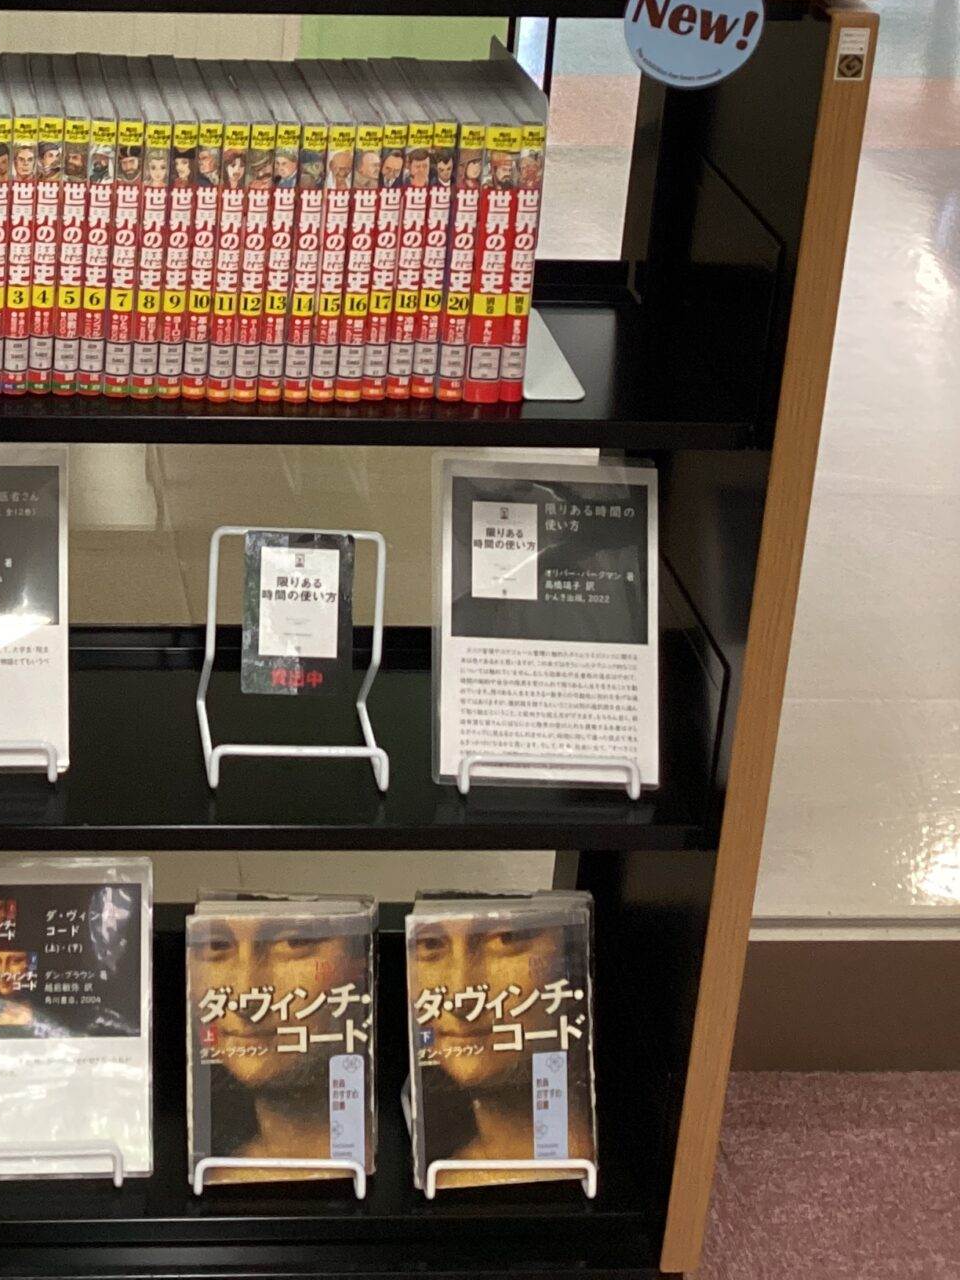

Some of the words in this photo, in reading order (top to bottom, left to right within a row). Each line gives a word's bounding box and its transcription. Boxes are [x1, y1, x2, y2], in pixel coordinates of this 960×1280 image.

[8, 182, 35, 286] 世界の歴史
[33, 182, 59, 285] 世界の歴史
[59, 182, 86, 286] 世界の歴史
[85, 184, 112, 286] 世界の歴史
[111, 185, 139, 288] 世界の歴史
[140, 186, 167, 291] 世界の歴史
[165, 187, 193, 291] 世界の歴史
[191, 186, 218, 290] 世界の歴史
[216, 189, 244, 293] 世界の歴史
[242, 189, 270, 293] 世界の歴史
[267, 188, 295, 291] 世界の歴史
[294, 189, 323, 292] 世界の歴史
[347, 190, 377, 292] 世界の歴史
[372, 187, 401, 290] 世界の歴史
[398, 187, 427, 290] 世界の歴史
[422, 186, 451, 289] 世界の歴史
[450, 189, 479, 292] 世界の歴史
[320, 190, 350, 293] 世界の歴史
[480, 190, 512, 294] 世界の歴史
[509, 190, 539, 294] 世界の歴史
[12, 291, 24, 305] 3
[36, 291, 49, 303] 4
[63, 291, 75, 304] 5
[89, 292, 100, 306] 6
[116, 293, 128, 307] 7
[143, 296, 155, 310] 8
[169, 296, 181, 309] 9
[192, 294, 210, 308] 10
[218, 297, 235, 311] 11
[242, 297, 261, 311] 12
[268, 295, 286, 310] 13
[296, 297, 313, 312] 14
[349, 297, 367, 312] 16
[375, 295, 391, 309] 17
[400, 295, 417, 309] 18
[424, 294, 441, 308] 19
[448, 296, 469, 311] 20
[323, 298, 340, 312] 15
[545, 503, 635, 518] 限りある時間の
[485, 527, 524, 539] 限りある
[544, 519, 580, 532] 使い方
[473, 539, 536, 552] 時間の使い方
[276, 575, 323, 589] 限りある
[261, 589, 337, 603] 時間の使い方
[45, 925, 80, 937] コード
[12, 980, 37, 991] コード
[198, 982, 371, 1024] ダ・ヴィンチ・
[414, 978, 585, 1025] ダ・ヴィンチ・
[203, 1030, 215, 1043] 上
[276, 1015, 372, 1054] コード
[420, 1031, 431, 1043] 下
[492, 1014, 586, 1051] コード
[199, 1046, 269, 1059] ダン・ブラウン
[417, 1045, 485, 1059] ダン・ブラウン
